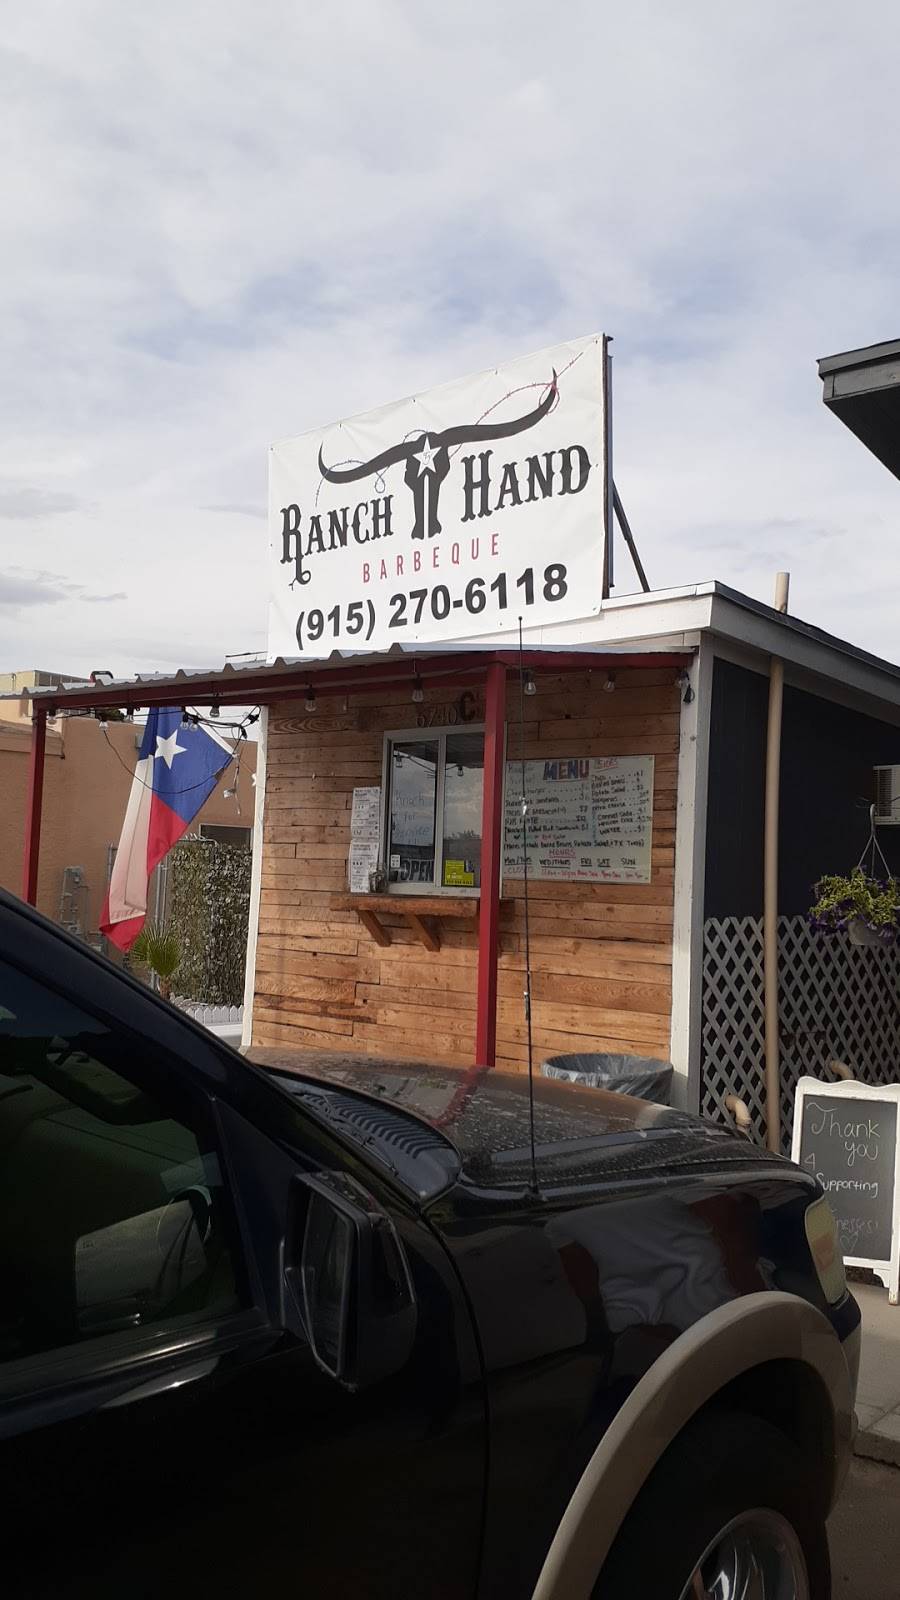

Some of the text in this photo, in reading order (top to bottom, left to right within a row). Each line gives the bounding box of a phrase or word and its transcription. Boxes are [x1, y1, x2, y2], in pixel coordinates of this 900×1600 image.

[280, 444, 592, 590] RANCH HAND
[362, 533, 500, 584] BARBEQUE
[295, 563, 568, 650] (915) 270-6118
[543, 759, 590, 780] MENU
[806, 1102, 881, 1138] Thank
[804, 1152, 816, 1171] 4
[844, 1139, 879, 1167] you
[816, 1172, 879, 1199] Supporting
